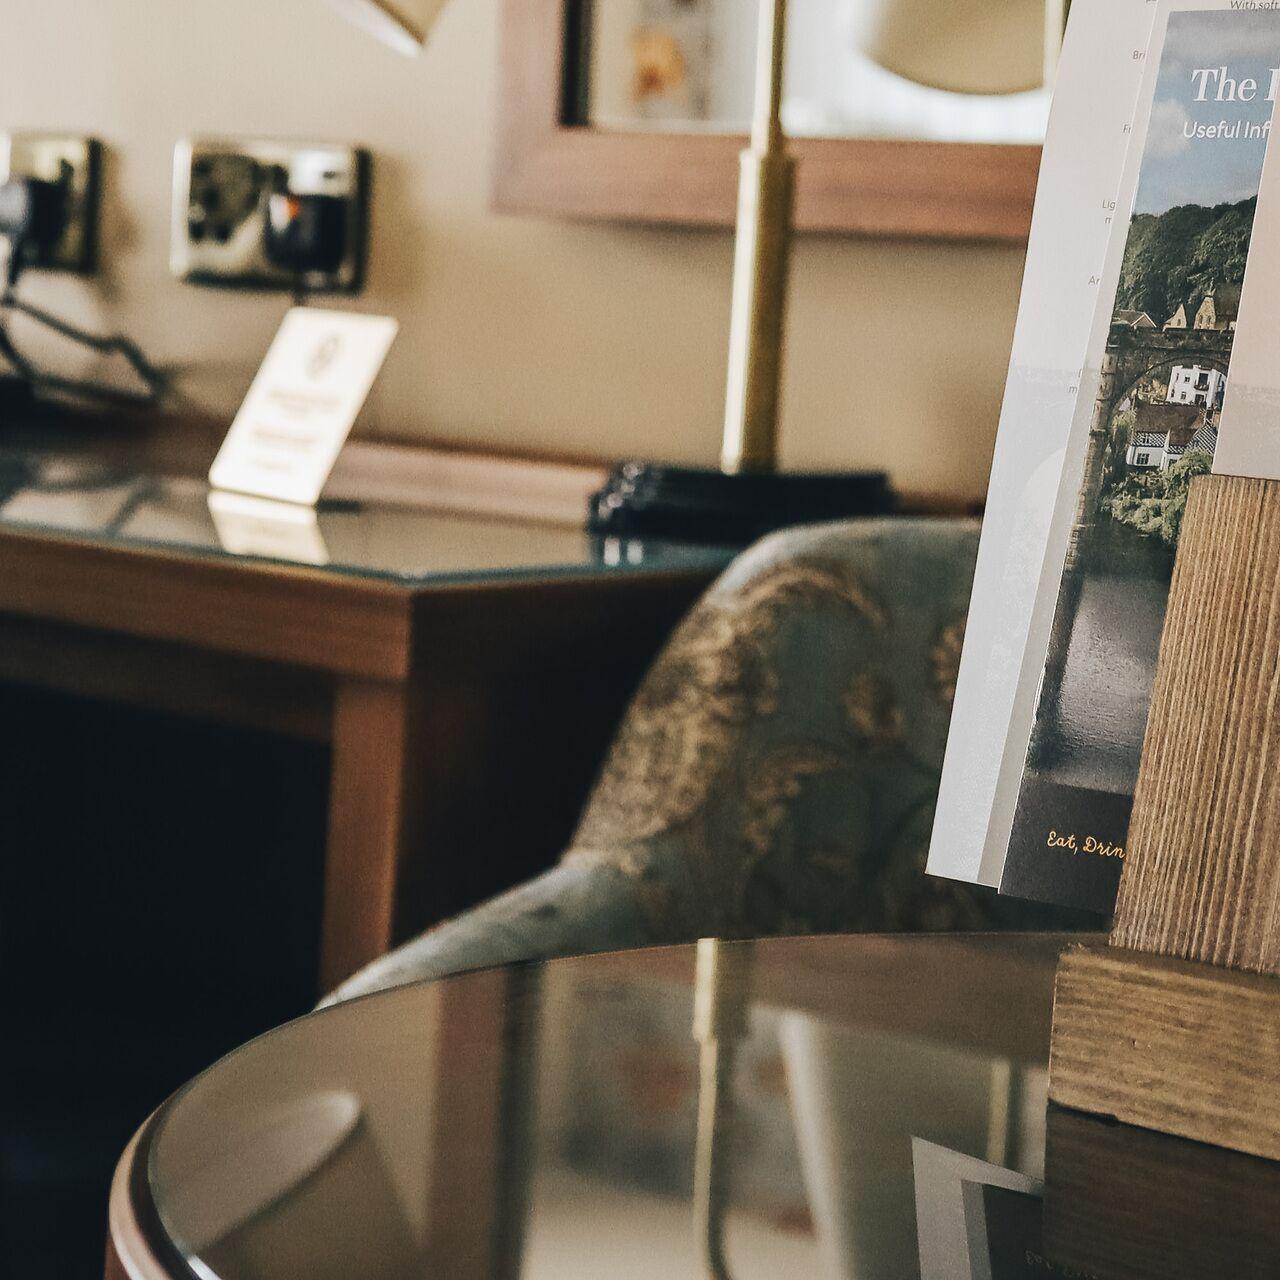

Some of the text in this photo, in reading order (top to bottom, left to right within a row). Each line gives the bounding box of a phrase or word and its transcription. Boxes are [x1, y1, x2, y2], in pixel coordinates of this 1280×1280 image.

[1190, 66, 1257, 103] The
[1182, 120, 1271, 140] Useful Inf
[1047, 830, 1126, 859] Eat, Drin
